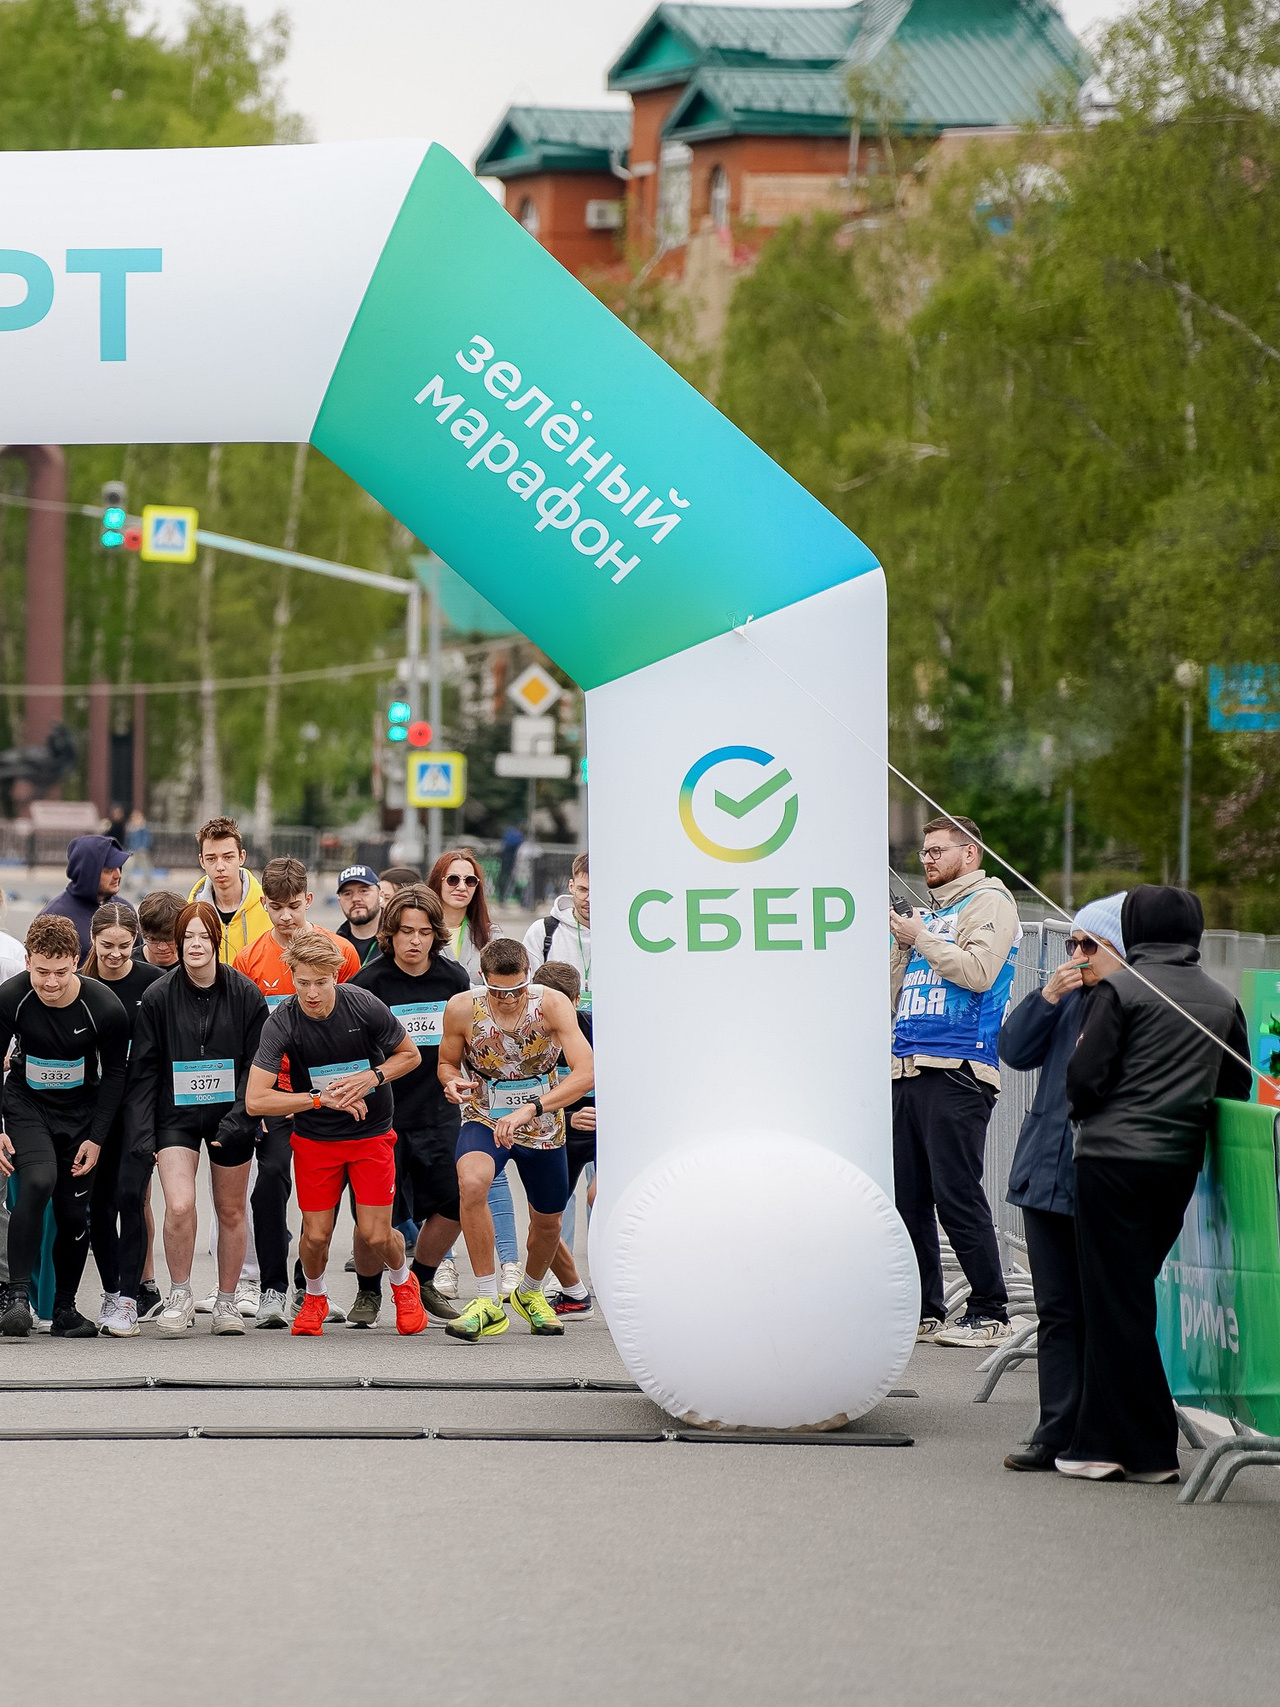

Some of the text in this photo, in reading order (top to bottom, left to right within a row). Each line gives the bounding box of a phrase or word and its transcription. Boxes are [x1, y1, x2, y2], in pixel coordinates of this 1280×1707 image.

[455, 334, 691, 545] зелёный
[413, 374, 641, 585] марафон
[628, 887, 856, 953] СБЕР
[406, 1020, 436, 1033] 3364
[40, 1072, 71, 1081] 3332
[190, 1078, 221, 1091] 3377
